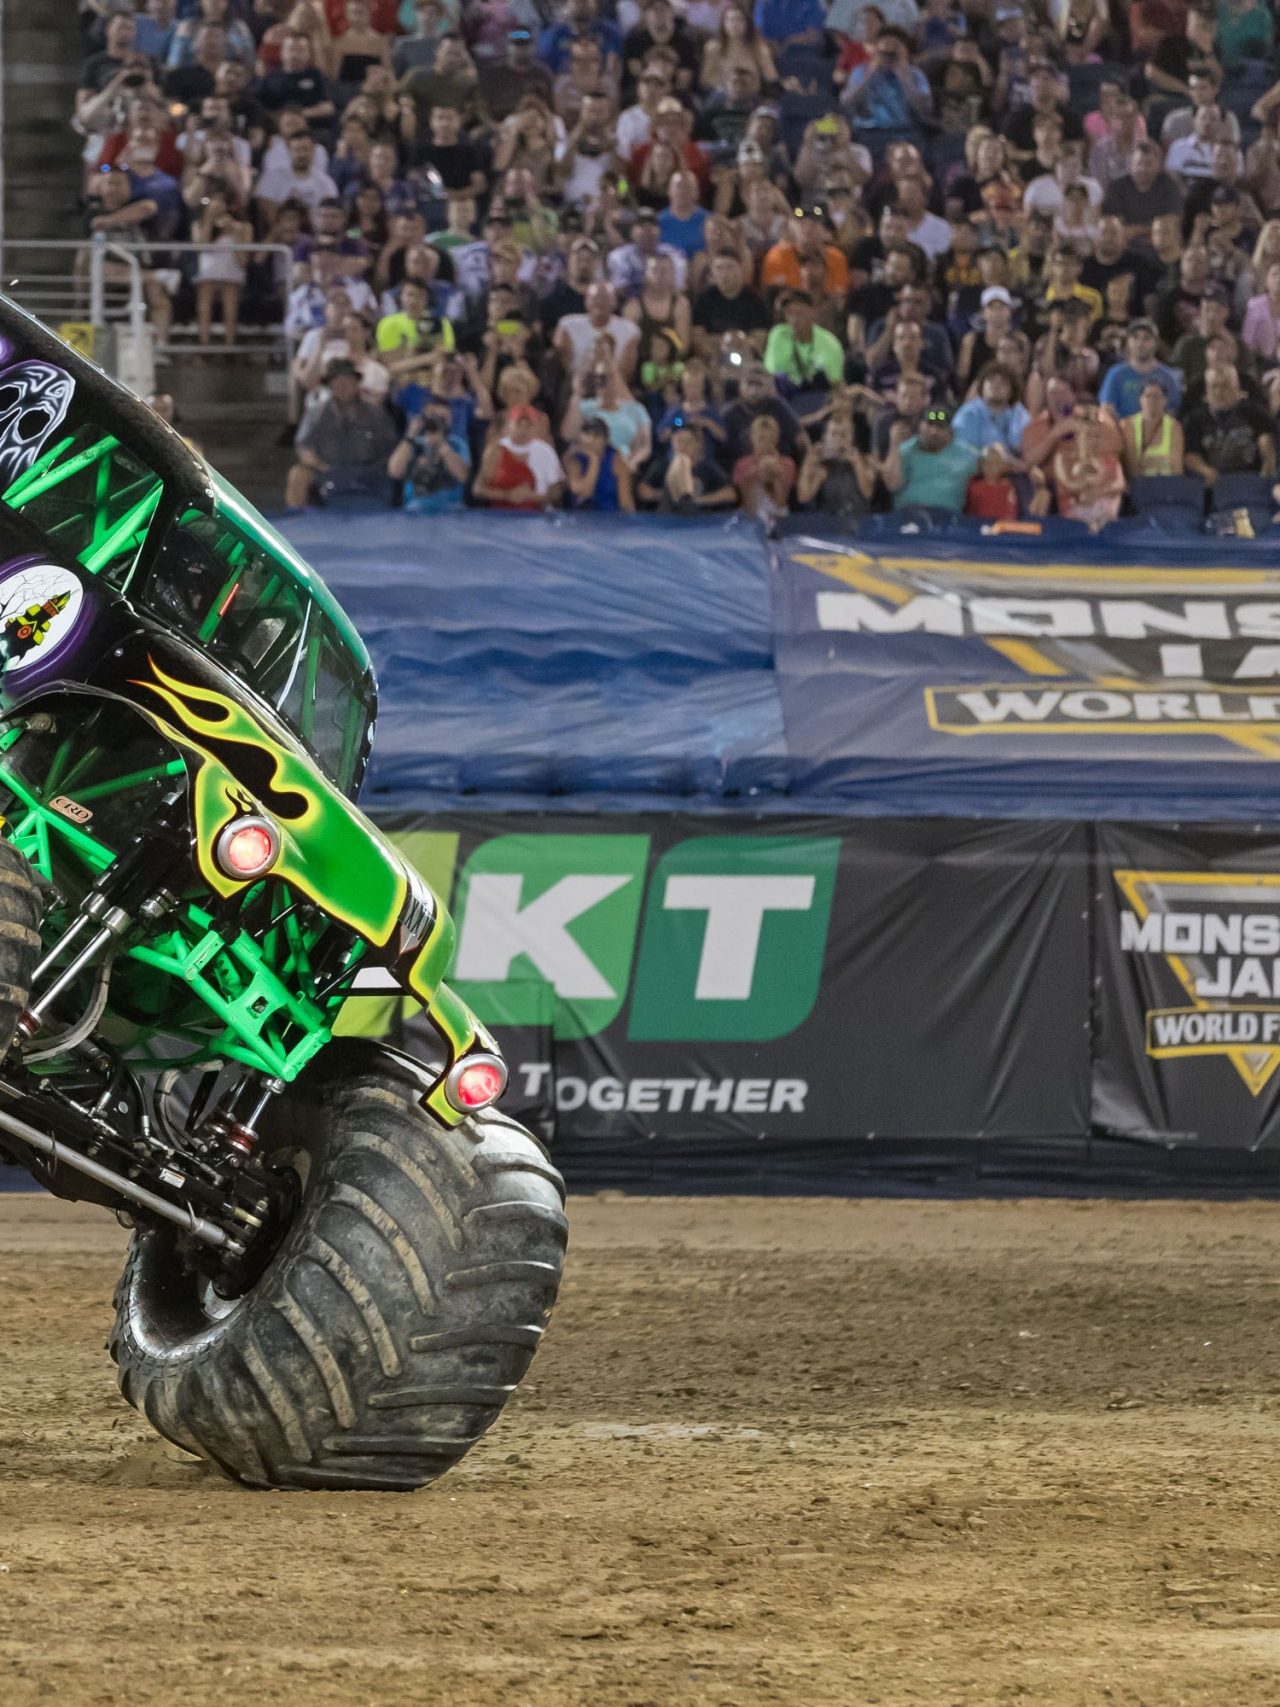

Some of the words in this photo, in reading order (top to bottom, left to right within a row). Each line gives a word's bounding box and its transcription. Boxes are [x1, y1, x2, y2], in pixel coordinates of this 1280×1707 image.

[1196, 957, 1280, 998] JA
[1155, 1012, 1259, 1045] WORLD
[519, 1062, 809, 1113] TOGETHER
